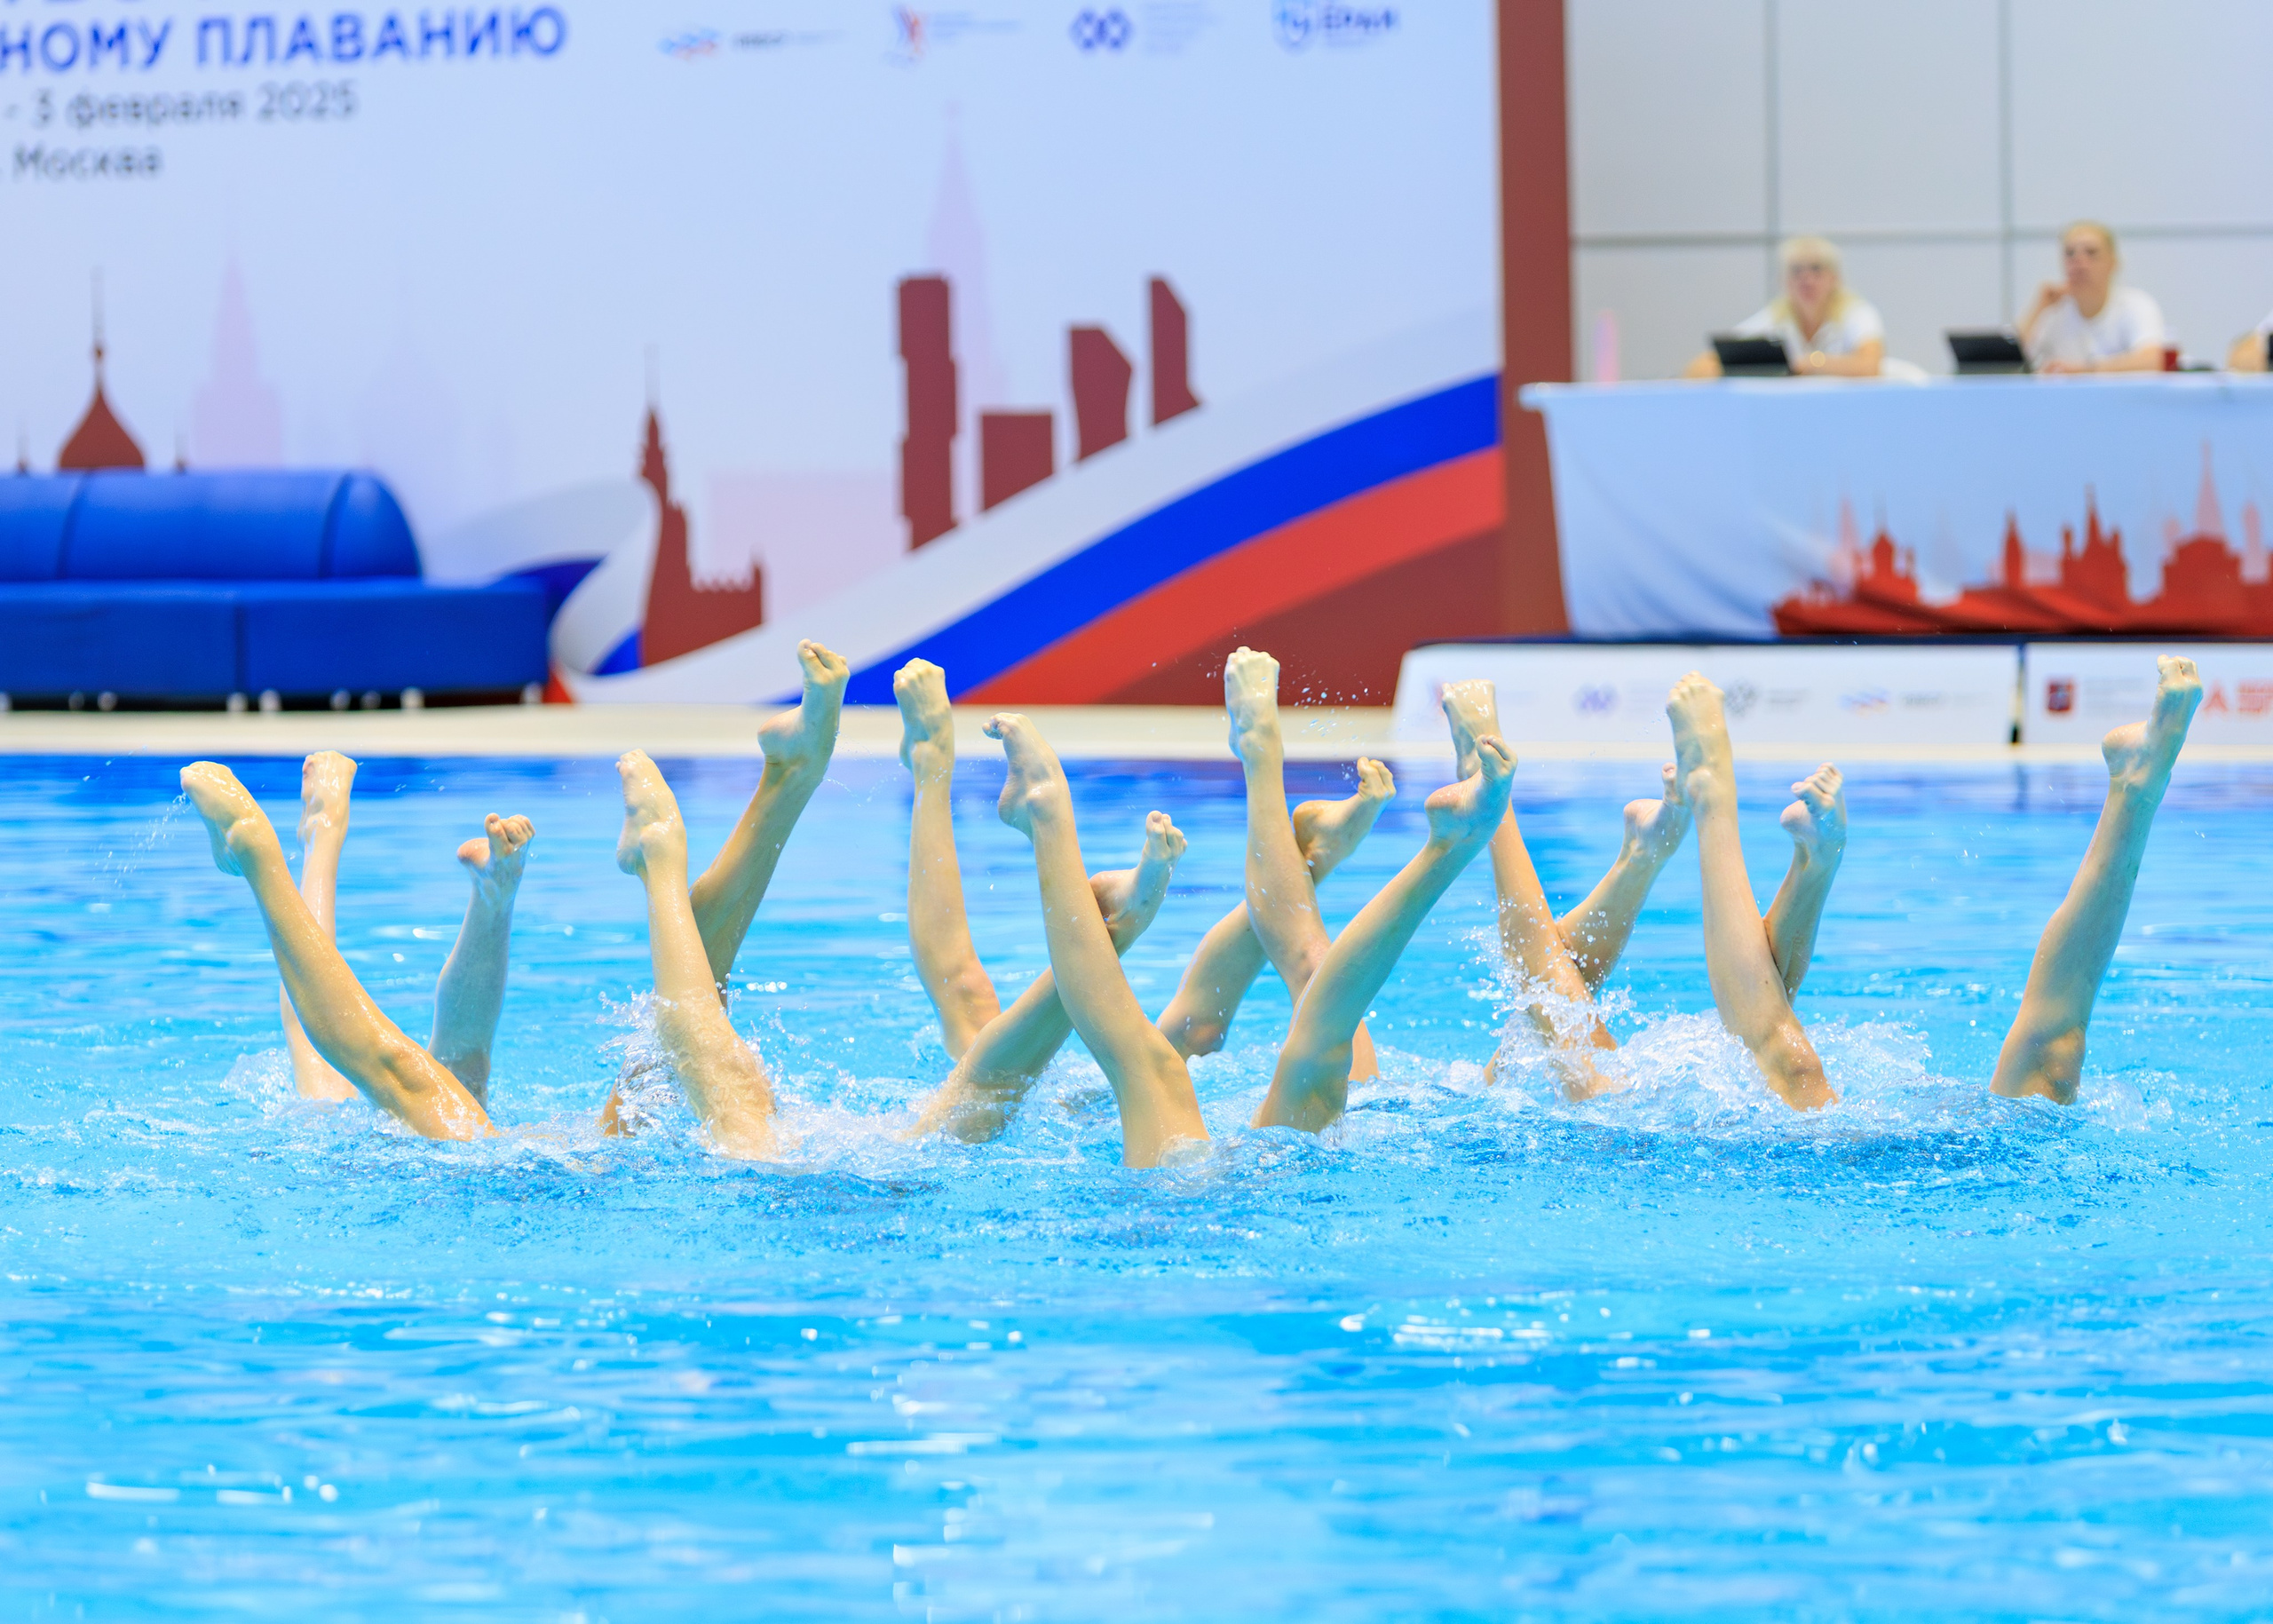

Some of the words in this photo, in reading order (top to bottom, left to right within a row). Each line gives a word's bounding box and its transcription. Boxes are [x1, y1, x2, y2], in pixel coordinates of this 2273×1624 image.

[196, 6, 568, 67] ПЛАВАНИЮ
[34, 88, 54, 126] 3
[67, 83, 244, 132] февраля
[257, 81, 358, 123] 2025
[12, 142, 164, 182] Москва
